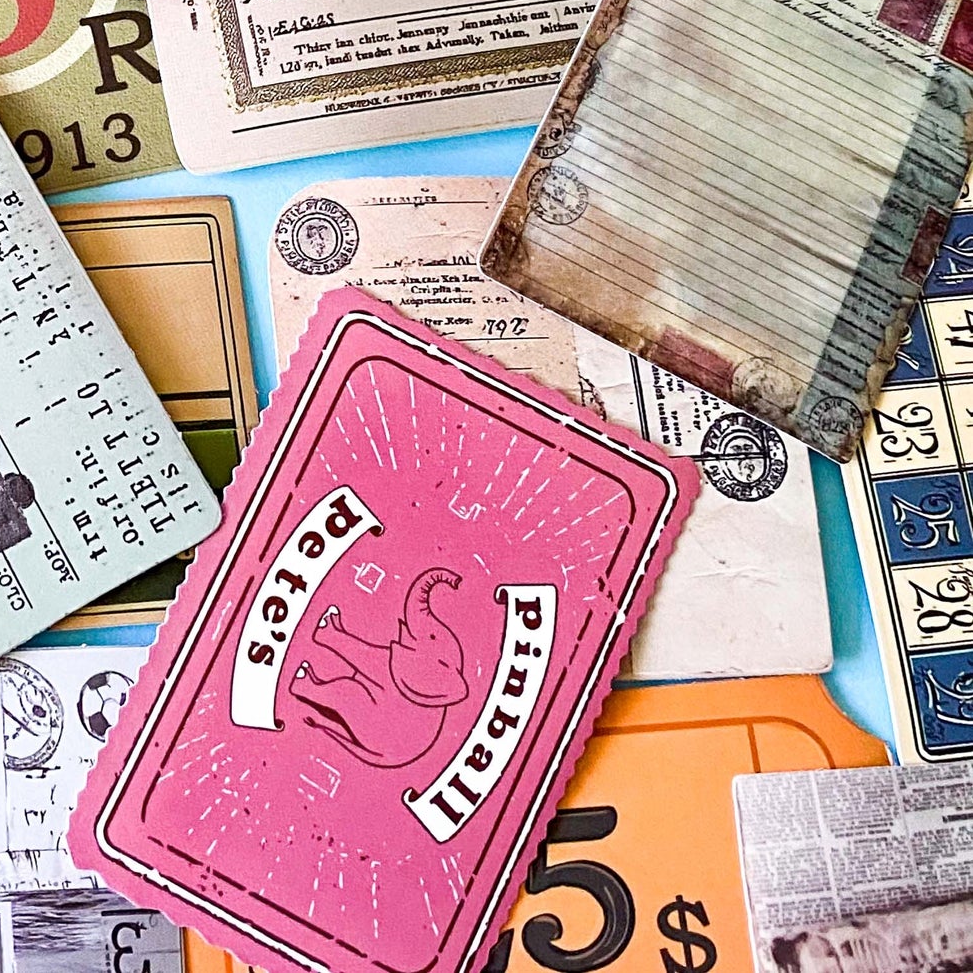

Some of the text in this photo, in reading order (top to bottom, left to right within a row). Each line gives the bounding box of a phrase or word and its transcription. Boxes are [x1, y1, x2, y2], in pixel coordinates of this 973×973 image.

[80, 10, 163, 96] R
[246, 495, 364, 668] pete's
[428, 596, 544, 830] pinball
